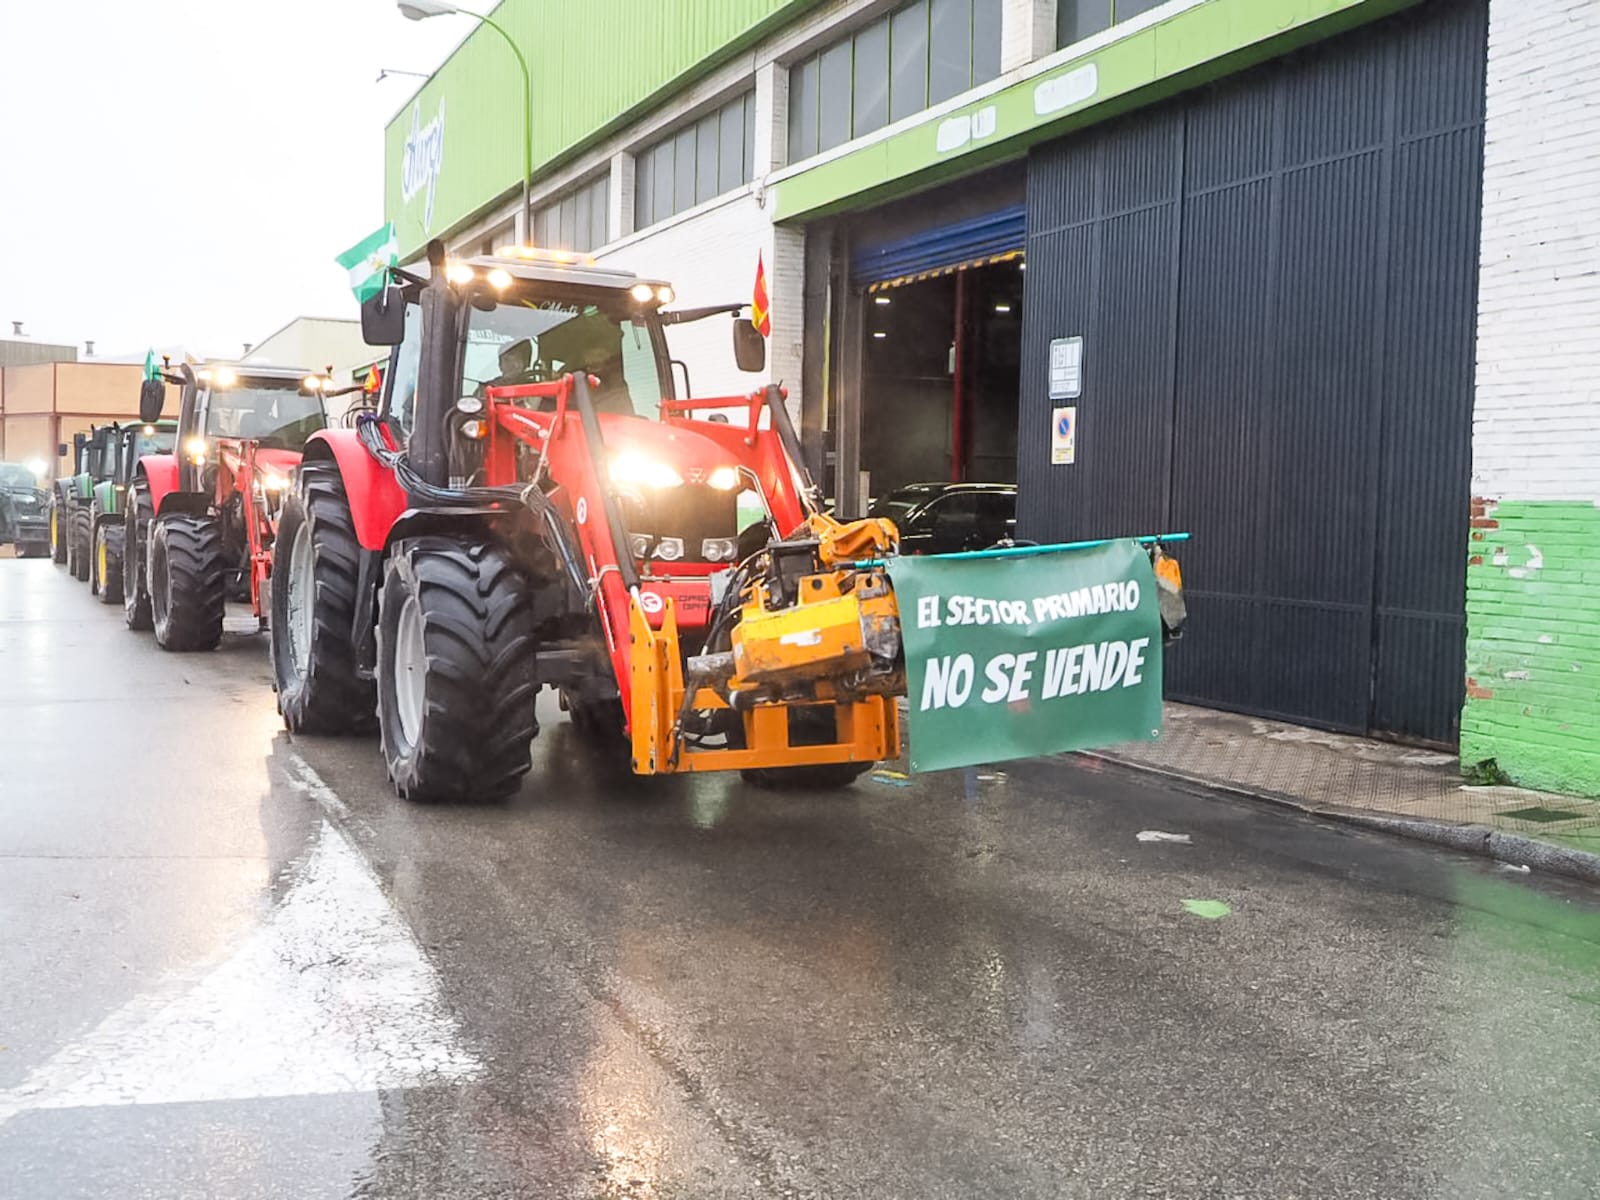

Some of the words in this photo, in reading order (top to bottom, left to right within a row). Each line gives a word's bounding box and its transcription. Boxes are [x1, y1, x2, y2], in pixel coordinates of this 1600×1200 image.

[917, 594, 942, 629] EL
[945, 594, 1032, 626] SECTOR
[1031, 579, 1141, 624] PRIMARIO
[920, 653, 975, 712] NO
[981, 651, 1038, 703] SE
[1041, 637, 1150, 701] VENDE
